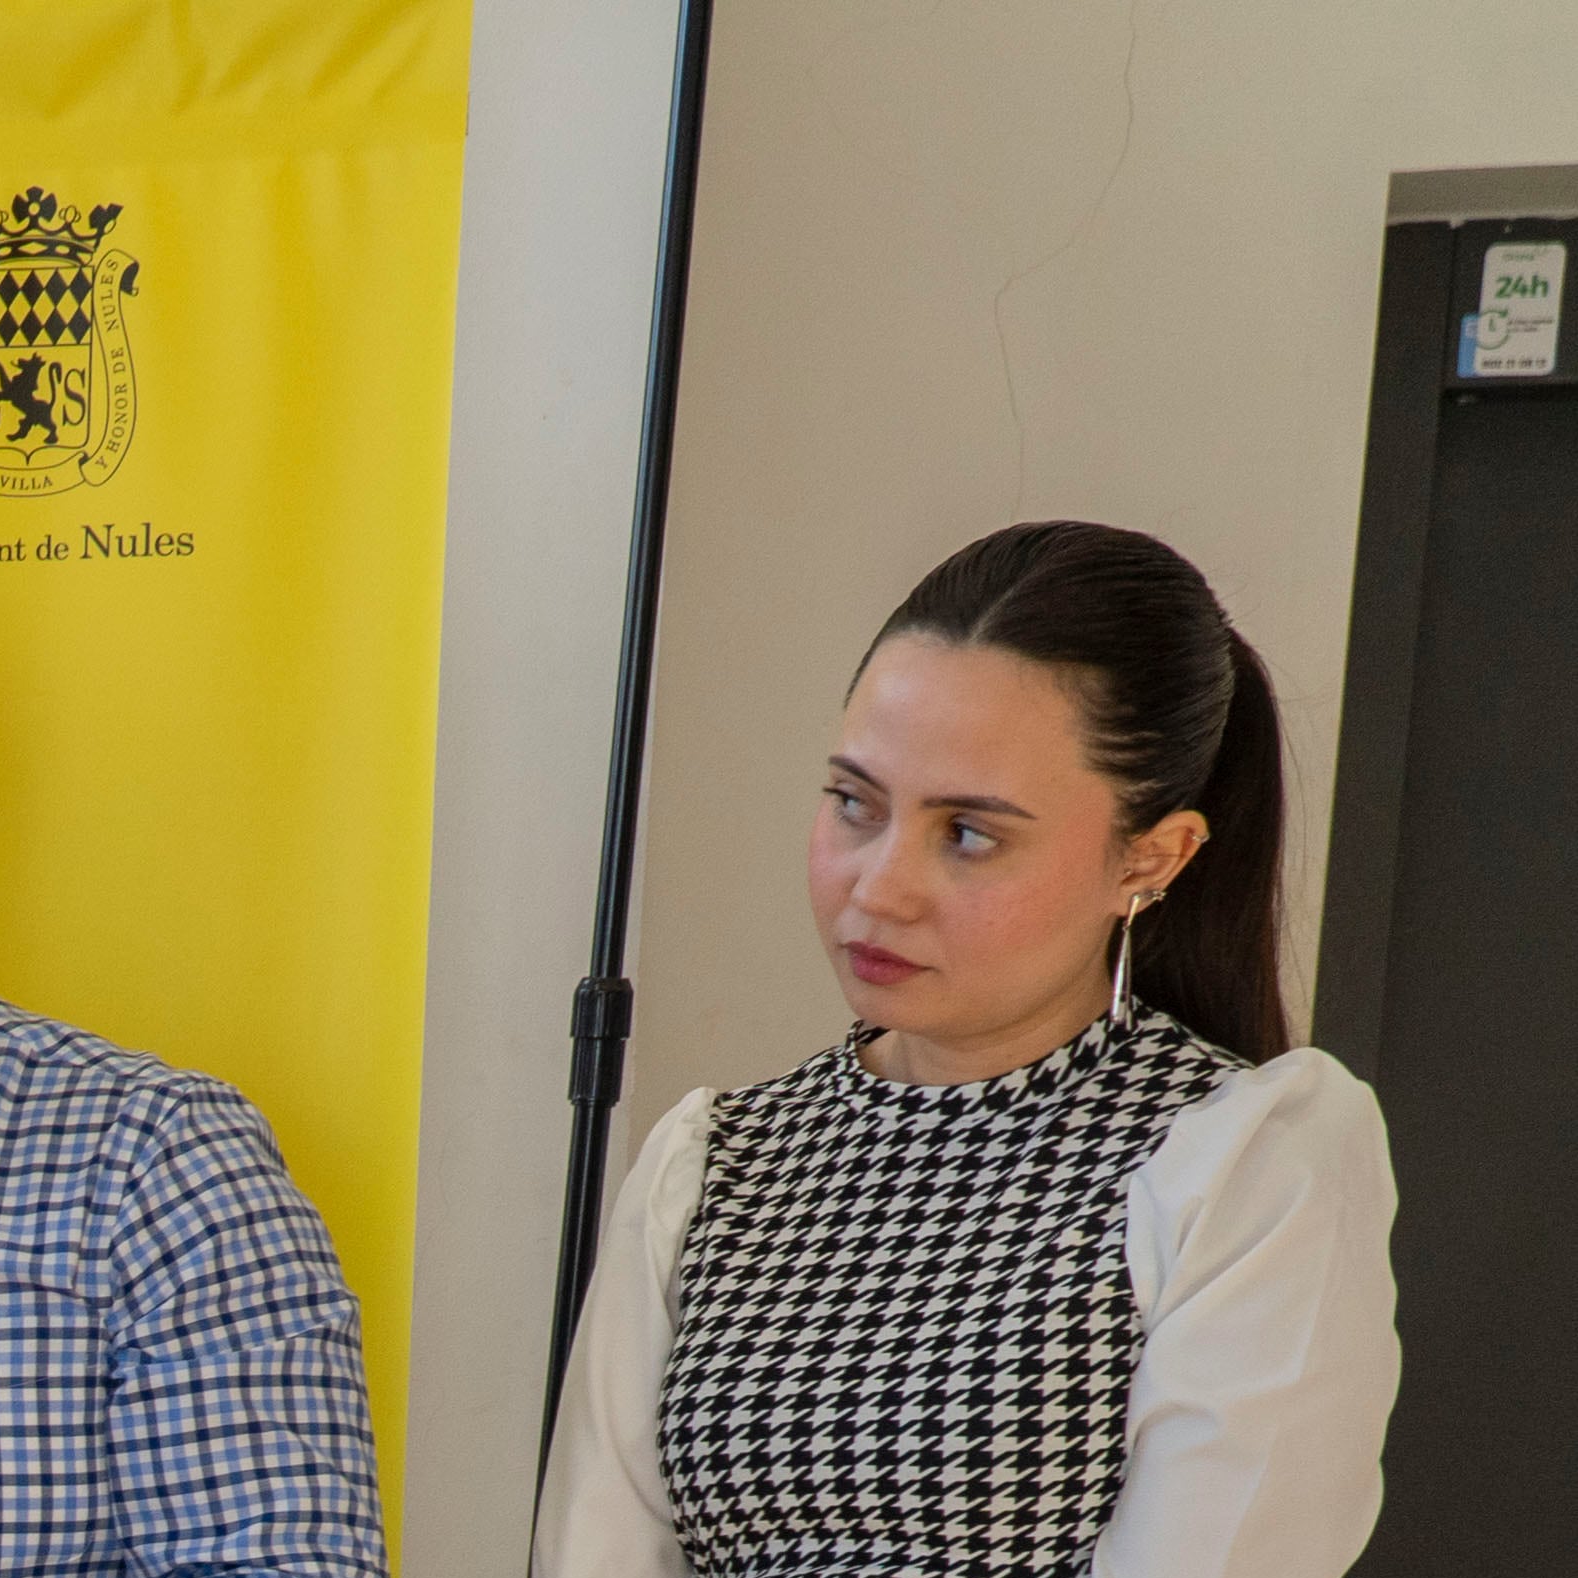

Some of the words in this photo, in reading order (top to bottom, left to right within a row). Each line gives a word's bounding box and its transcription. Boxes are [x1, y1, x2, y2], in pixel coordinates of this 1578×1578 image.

[99, 259, 118, 332] NULES
[1496, 276, 1548, 299] 24h
[112, 347, 125, 374] DE
[62, 367, 87, 427] S
[108, 383, 128, 454] HONOR
[0, 475, 53, 490] VILLA
[35, 535, 70, 561] de
[80, 522, 195, 560] Nules
